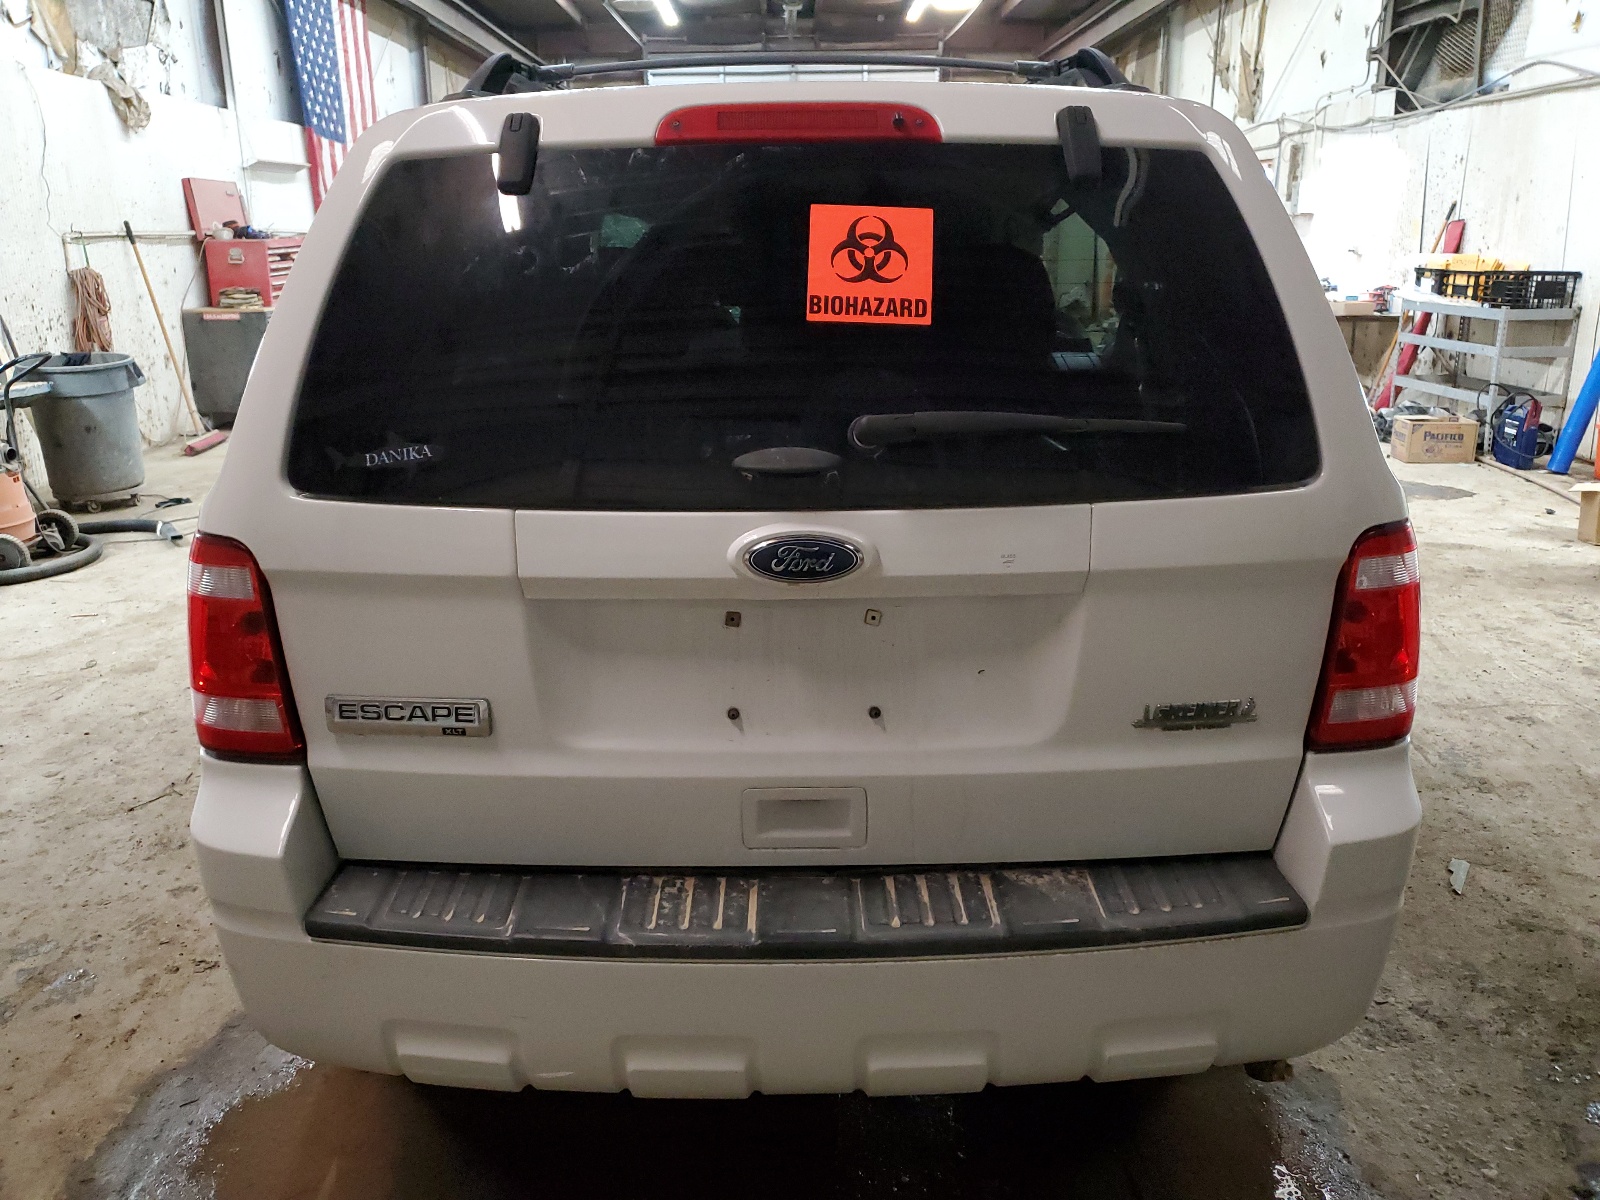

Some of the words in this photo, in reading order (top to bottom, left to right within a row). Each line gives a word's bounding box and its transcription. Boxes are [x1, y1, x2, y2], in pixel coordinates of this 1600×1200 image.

[808, 295, 928, 318] BIOHAZARD
[365, 444, 433, 467] DANIKA
[771, 545, 835, 572] Ford
[338, 703, 476, 723] ESCAPE
[445, 728, 464, 736] XLT
